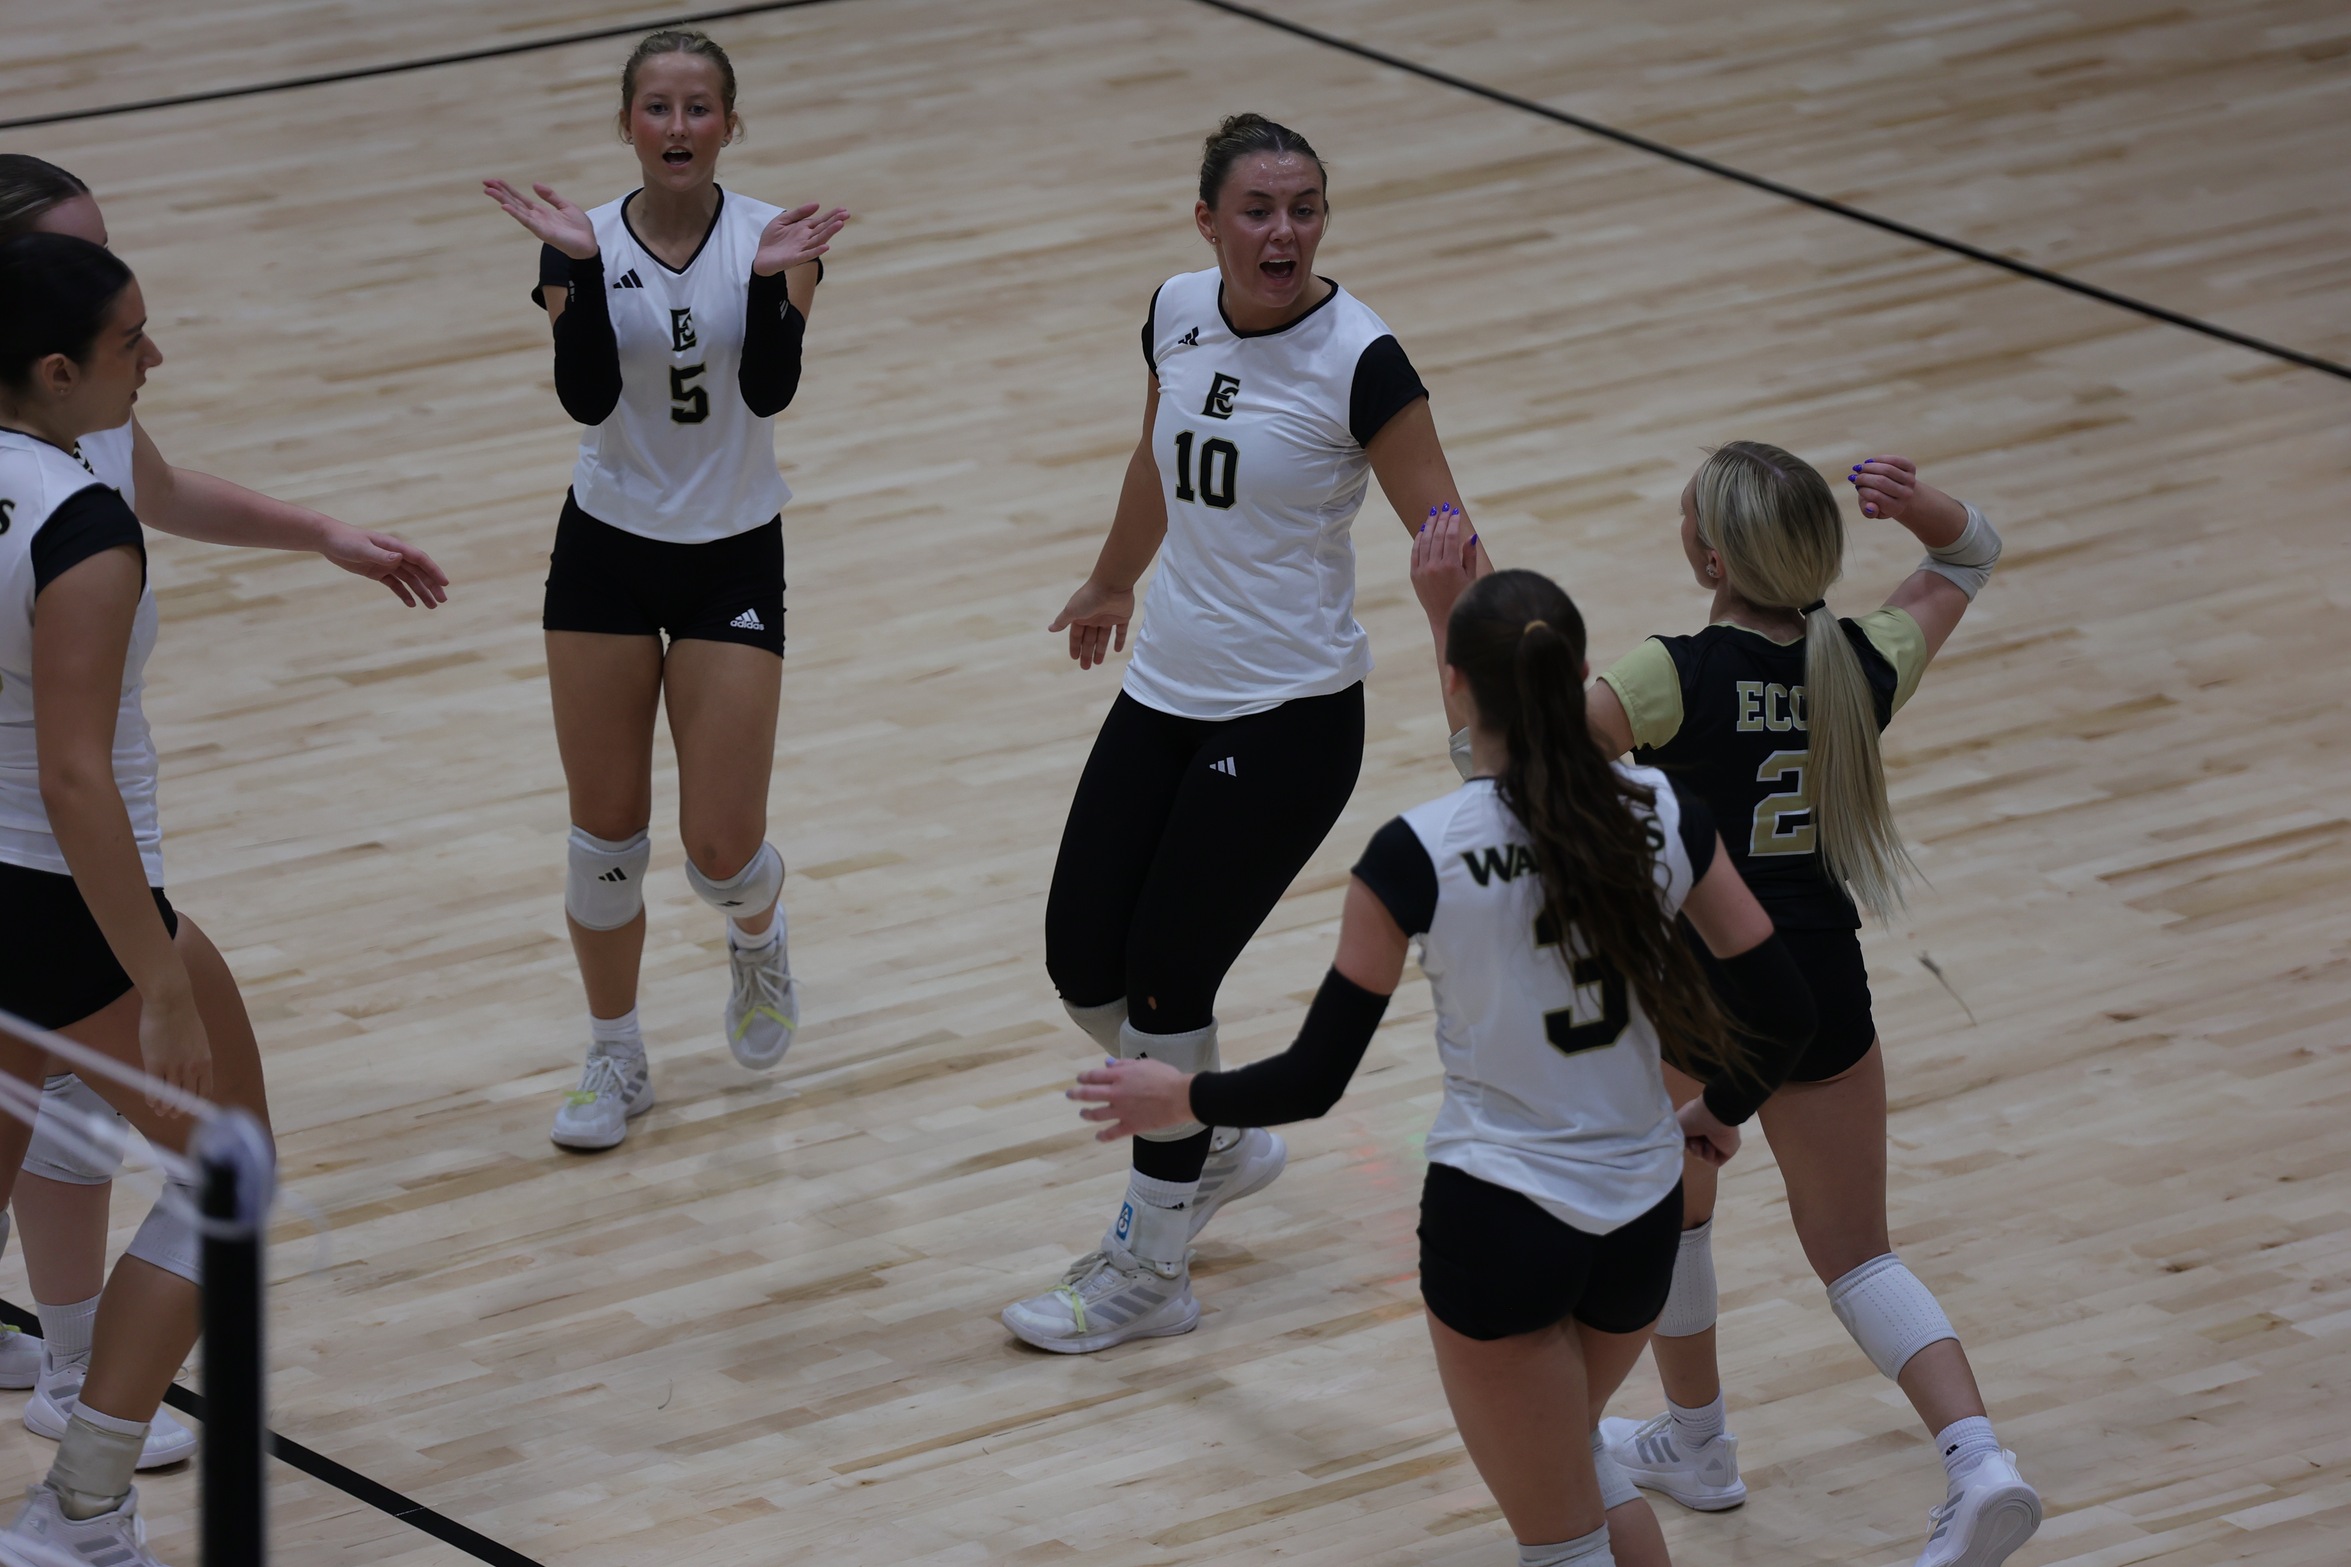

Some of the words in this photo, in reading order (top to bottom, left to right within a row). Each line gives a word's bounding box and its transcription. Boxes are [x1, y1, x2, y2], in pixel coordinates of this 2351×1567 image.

[669, 361, 709, 424] 5
[1174, 429, 1240, 511] 10
[730, 619, 765, 631] adidas
[1736, 680, 1808, 732] ECC
[1748, 749, 1817, 857] 2
